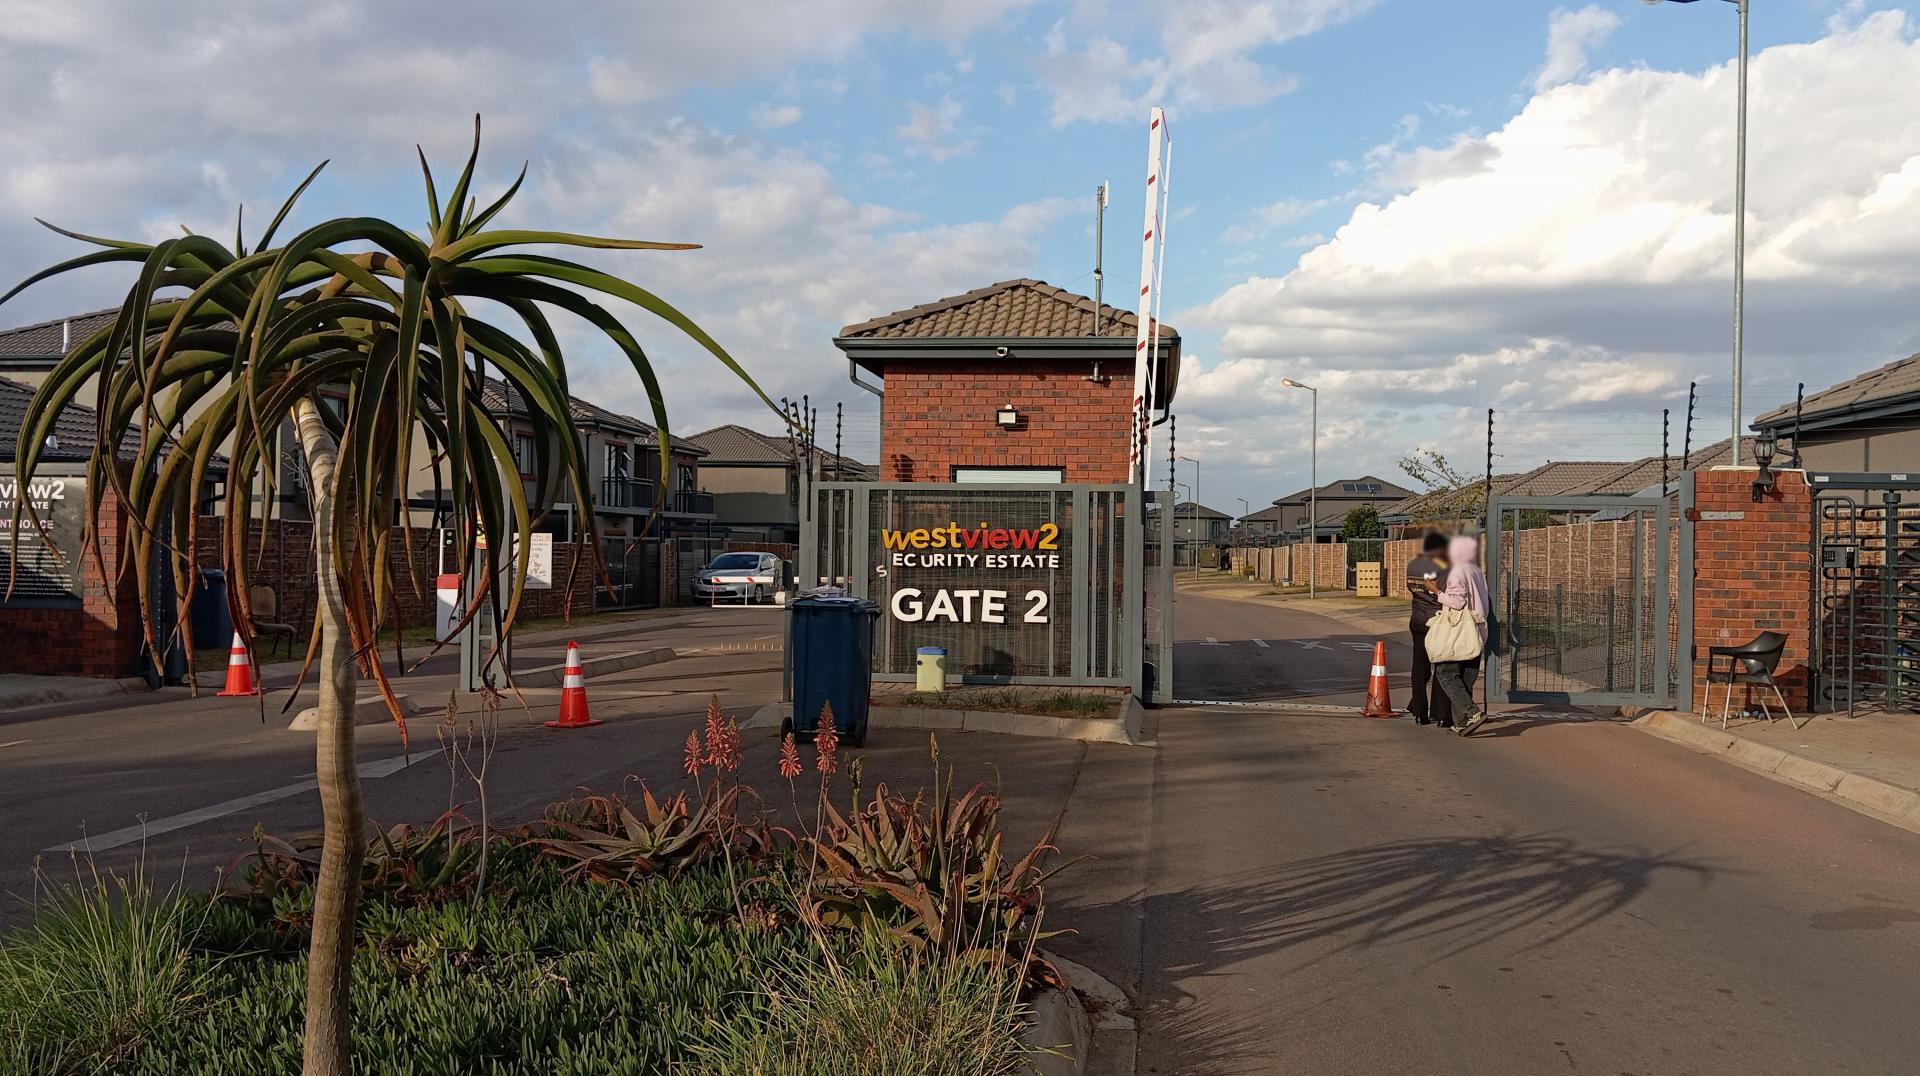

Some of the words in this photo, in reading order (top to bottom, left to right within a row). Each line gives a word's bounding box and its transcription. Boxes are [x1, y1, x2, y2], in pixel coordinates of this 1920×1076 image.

[882, 521, 1059, 550] westview2
[985, 554, 1060, 568] ESTATE
[891, 587, 1007, 624] GATE
[1023, 589, 1048, 623] 2
